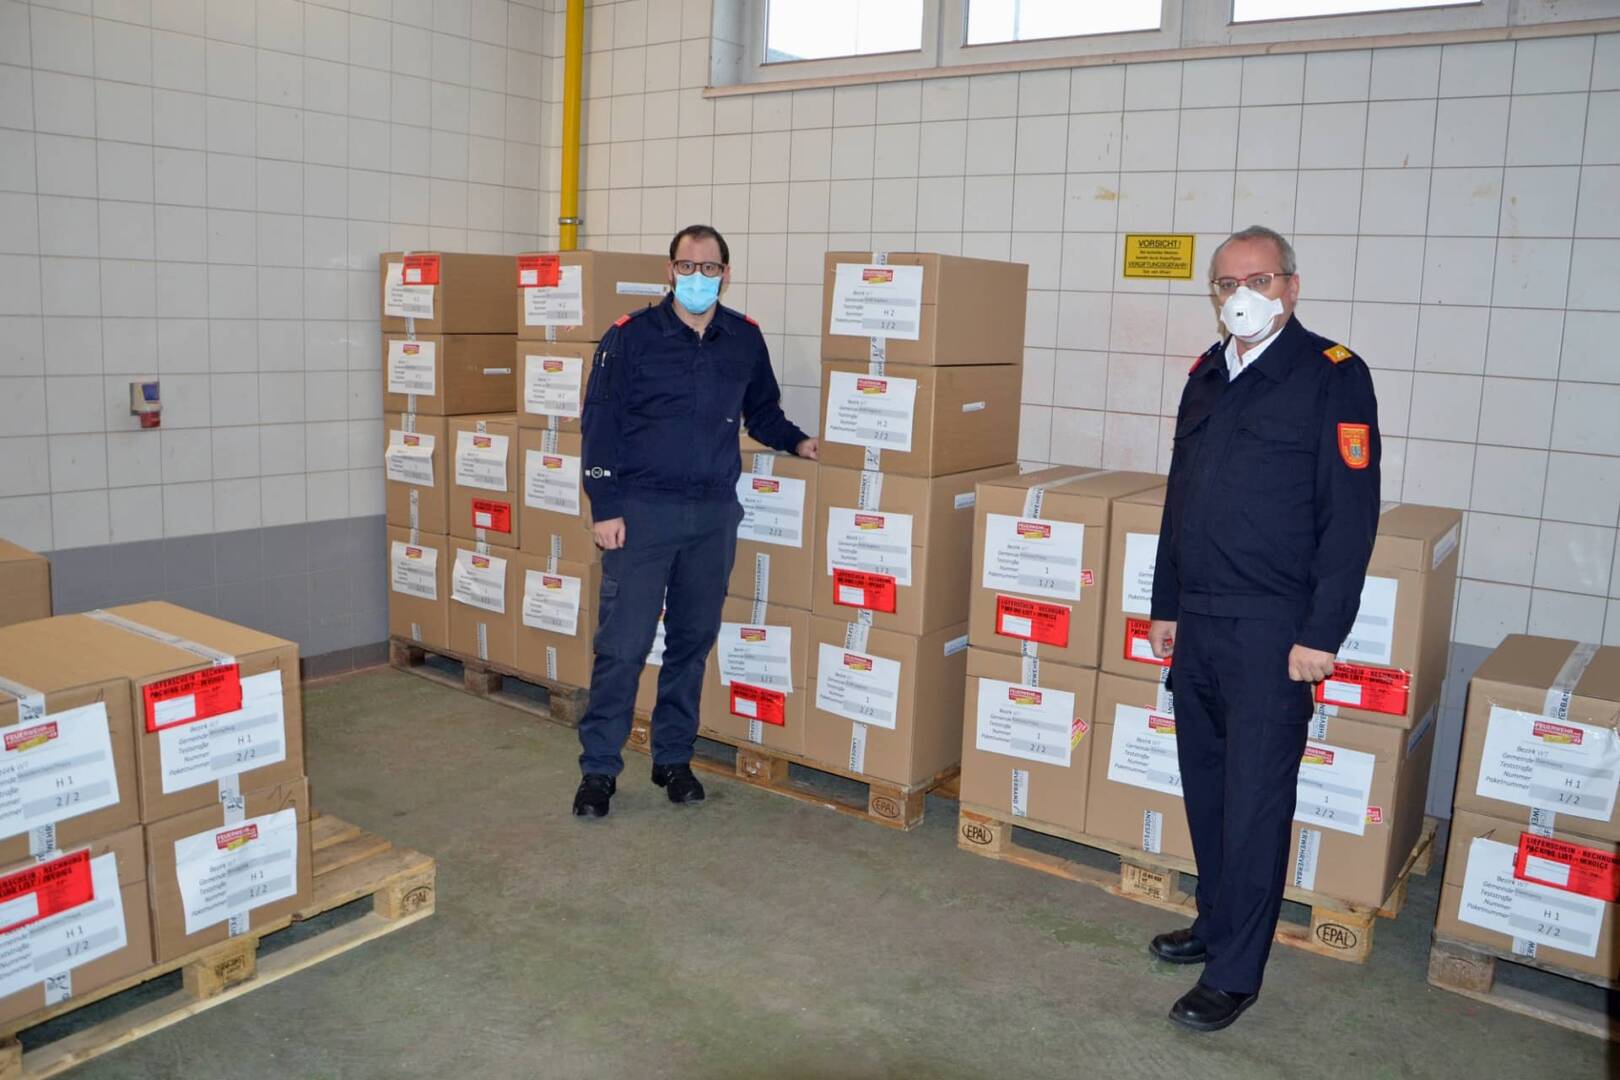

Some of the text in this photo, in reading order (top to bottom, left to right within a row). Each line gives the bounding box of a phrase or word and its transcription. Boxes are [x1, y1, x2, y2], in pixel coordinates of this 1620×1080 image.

[238, 735, 252, 744] H 1
[56, 776, 74, 788] H 1
[1565, 778, 1581, 789] H 1
[968, 825, 987, 842] EPAL
[251, 870, 264, 881] H 1
[1544, 910, 1560, 921] H 1
[66, 926, 83, 938] H 1
[1323, 927, 1348, 946] EPAL
